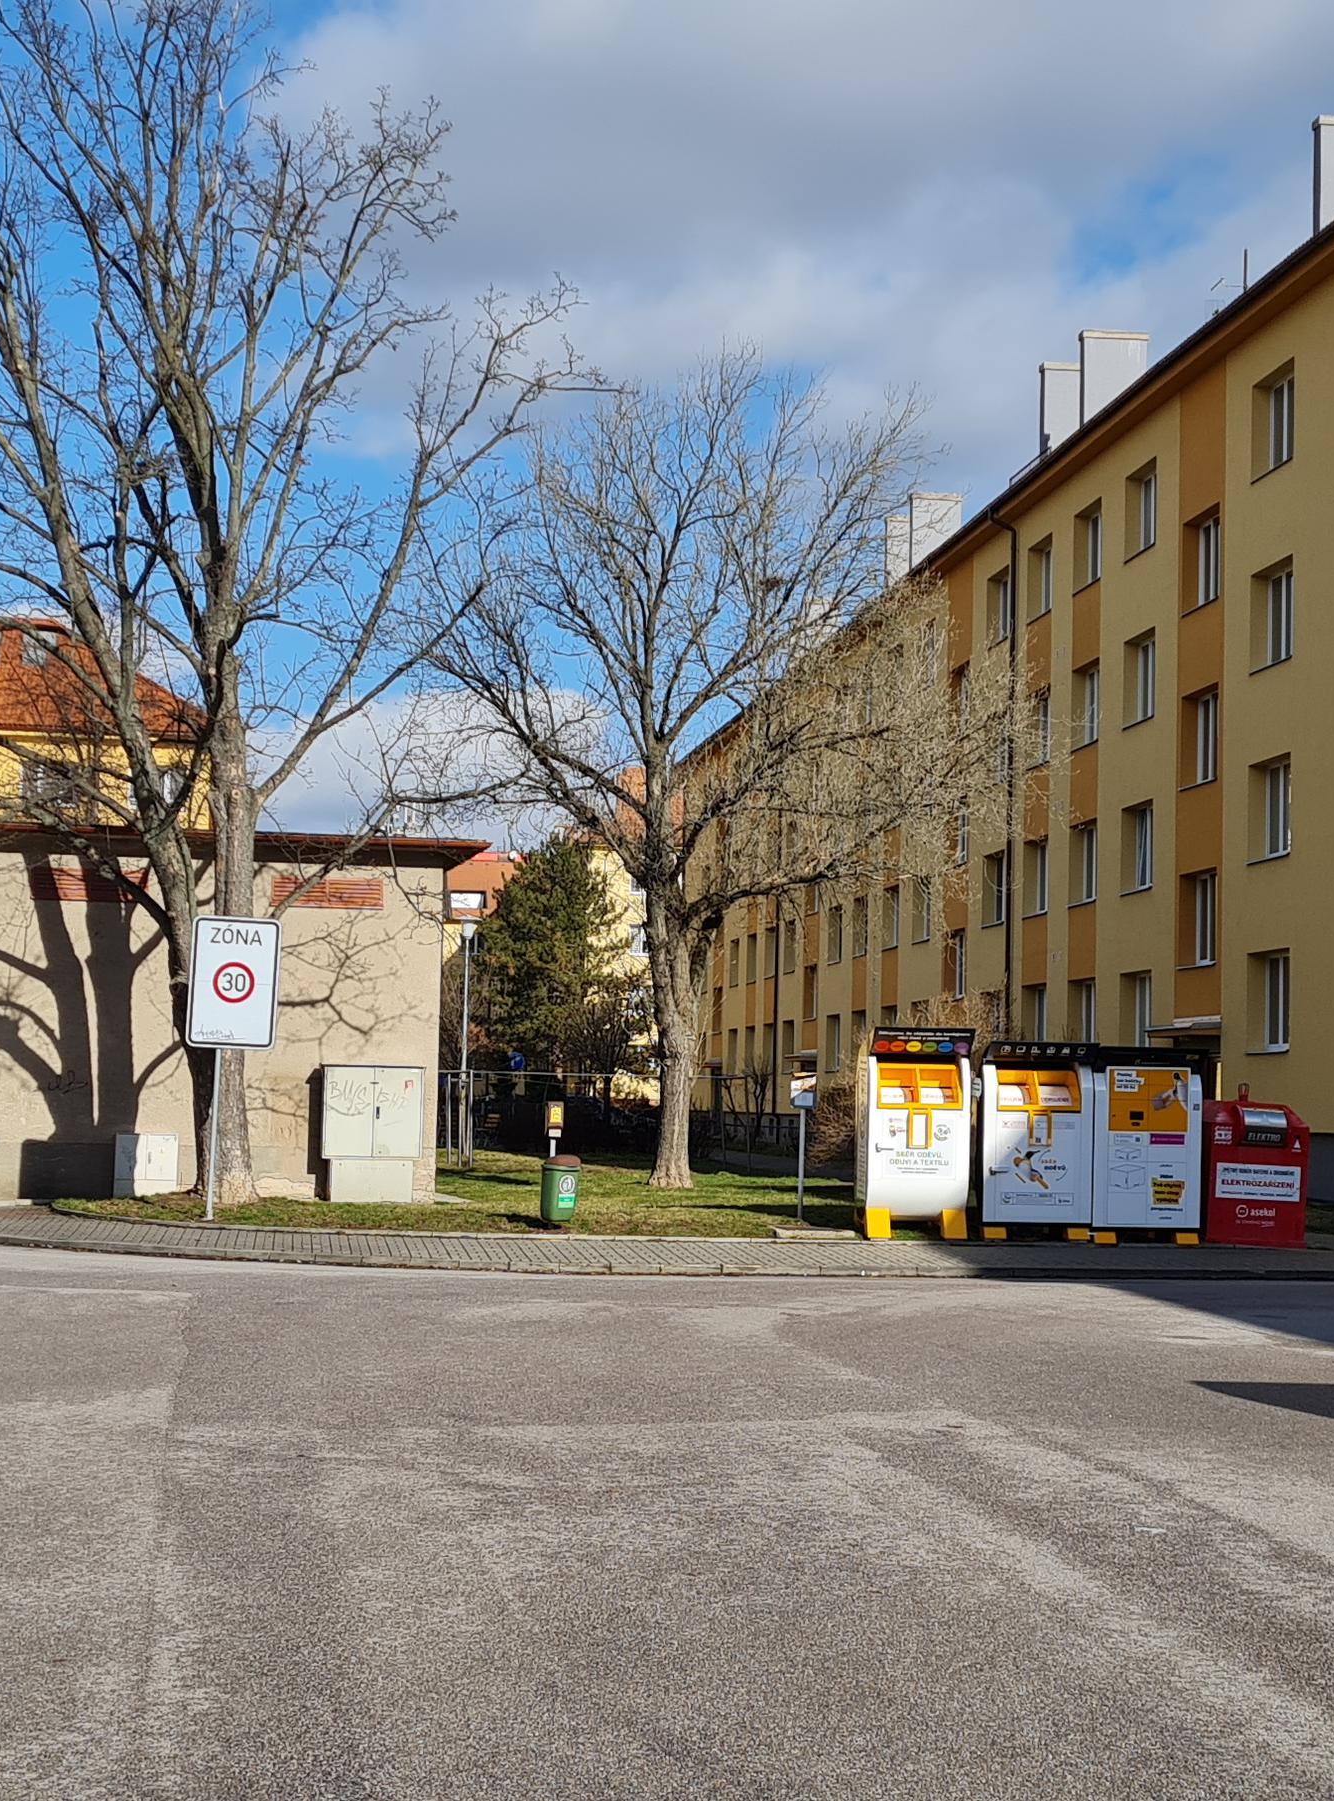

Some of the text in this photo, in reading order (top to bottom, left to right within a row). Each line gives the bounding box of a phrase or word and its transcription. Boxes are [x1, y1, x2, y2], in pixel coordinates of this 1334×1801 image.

[210, 924, 263, 947] ZÓNA
[222, 973, 247, 993] 30
[1248, 1132, 1282, 1142] ELEKTRO
[1250, 1208, 1276, 1217] asekol
